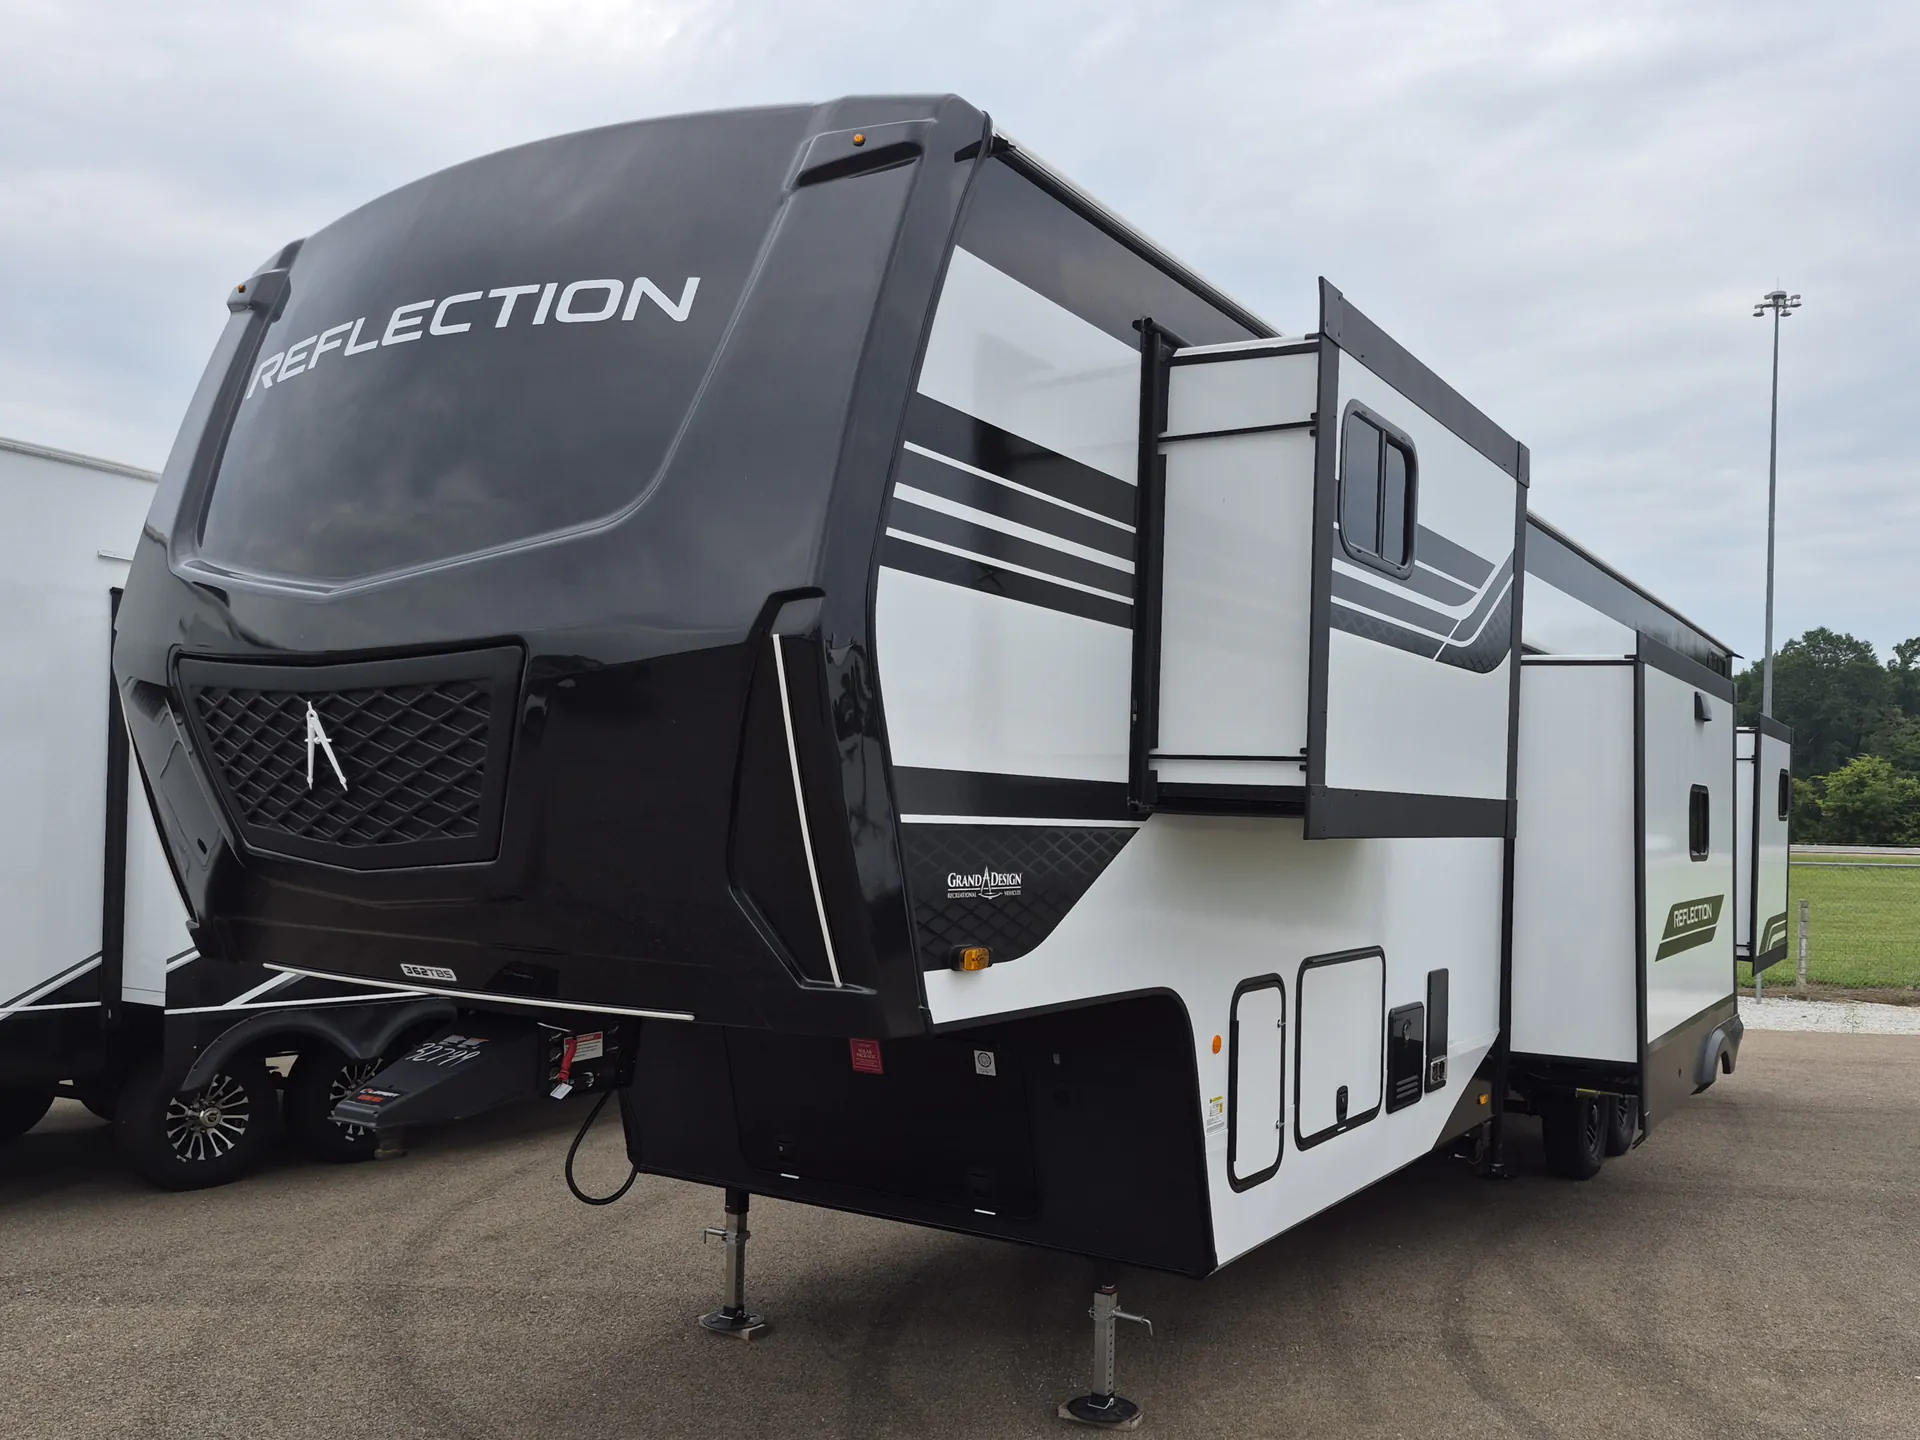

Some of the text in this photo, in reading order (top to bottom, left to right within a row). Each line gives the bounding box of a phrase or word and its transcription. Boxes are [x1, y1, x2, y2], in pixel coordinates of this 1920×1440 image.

[246, 276, 702, 400] REFLECTION
[947, 871, 1022, 888] GRAND DESIGN
[1673, 903, 1713, 929] REFLECTION
[403, 965, 454, 980] 362TBS
